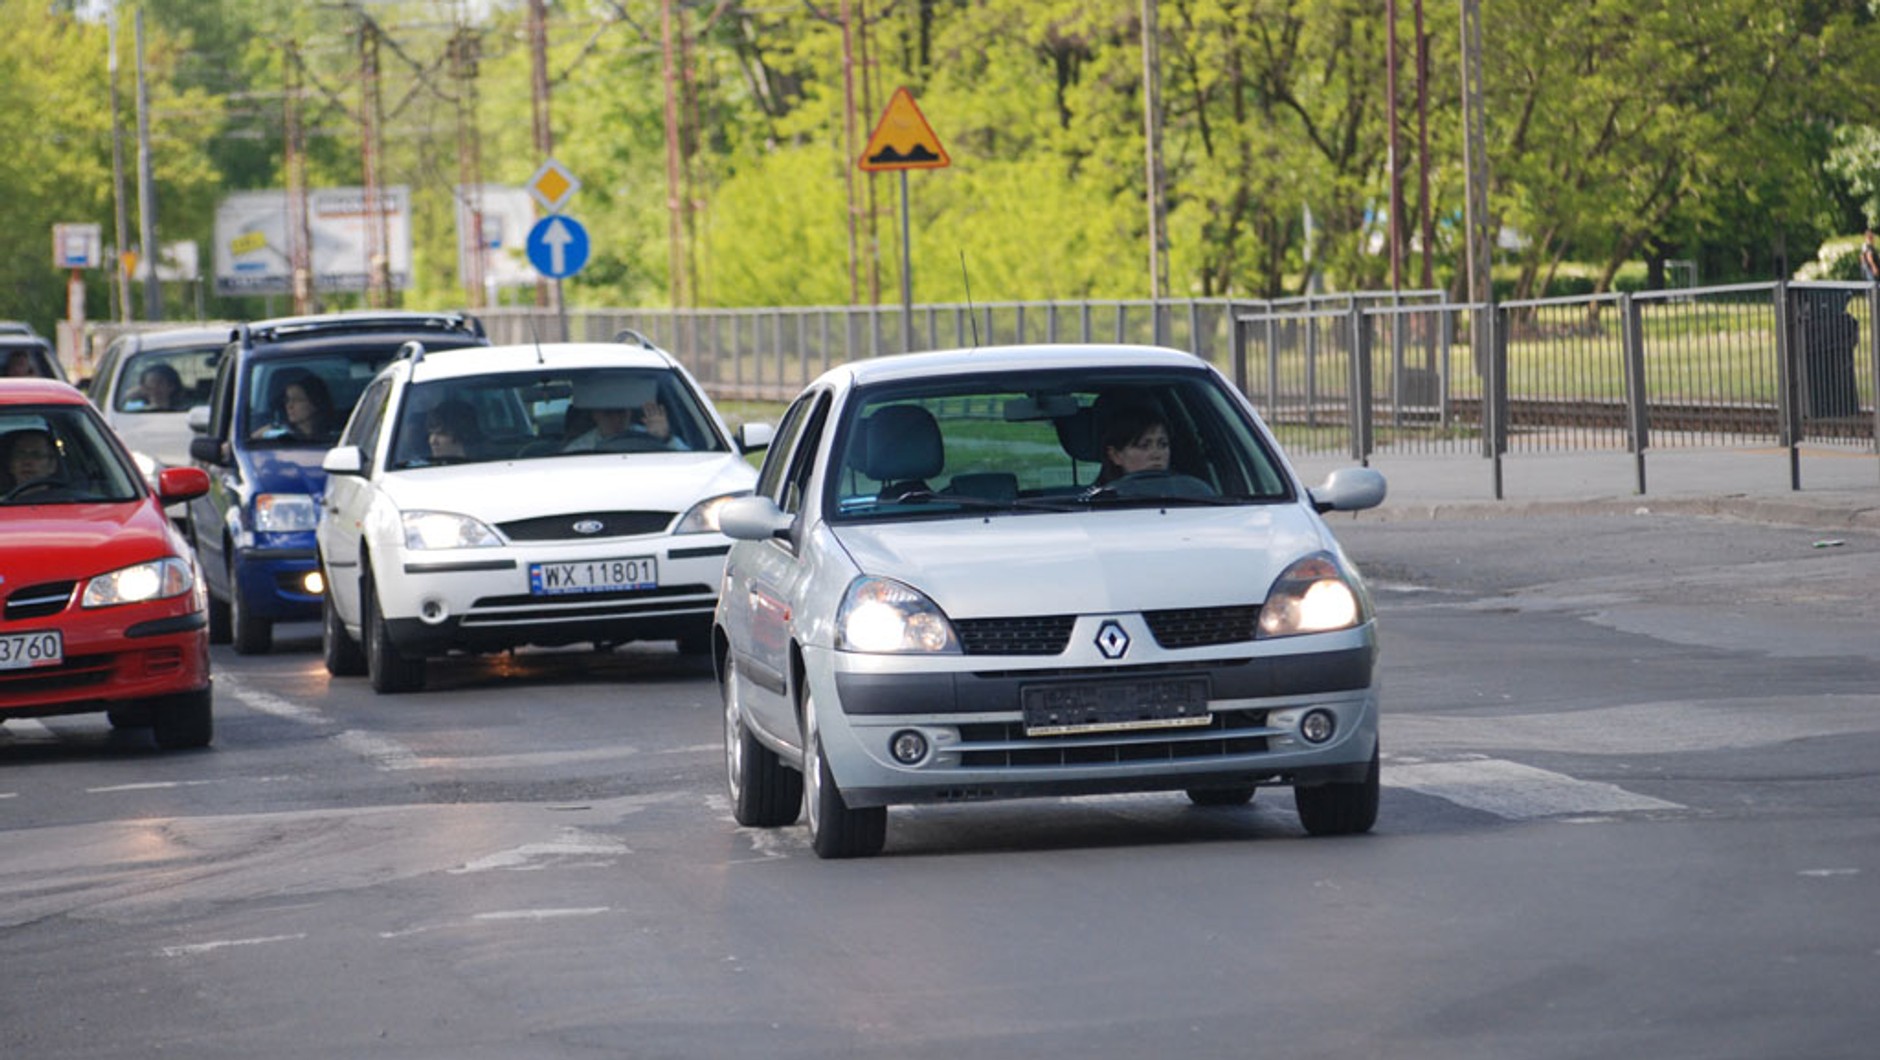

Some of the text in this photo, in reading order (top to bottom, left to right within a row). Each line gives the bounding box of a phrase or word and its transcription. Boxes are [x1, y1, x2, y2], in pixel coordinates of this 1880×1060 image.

[545, 560, 650, 586] WX 11801
[0, 634, 57, 661] 3760
